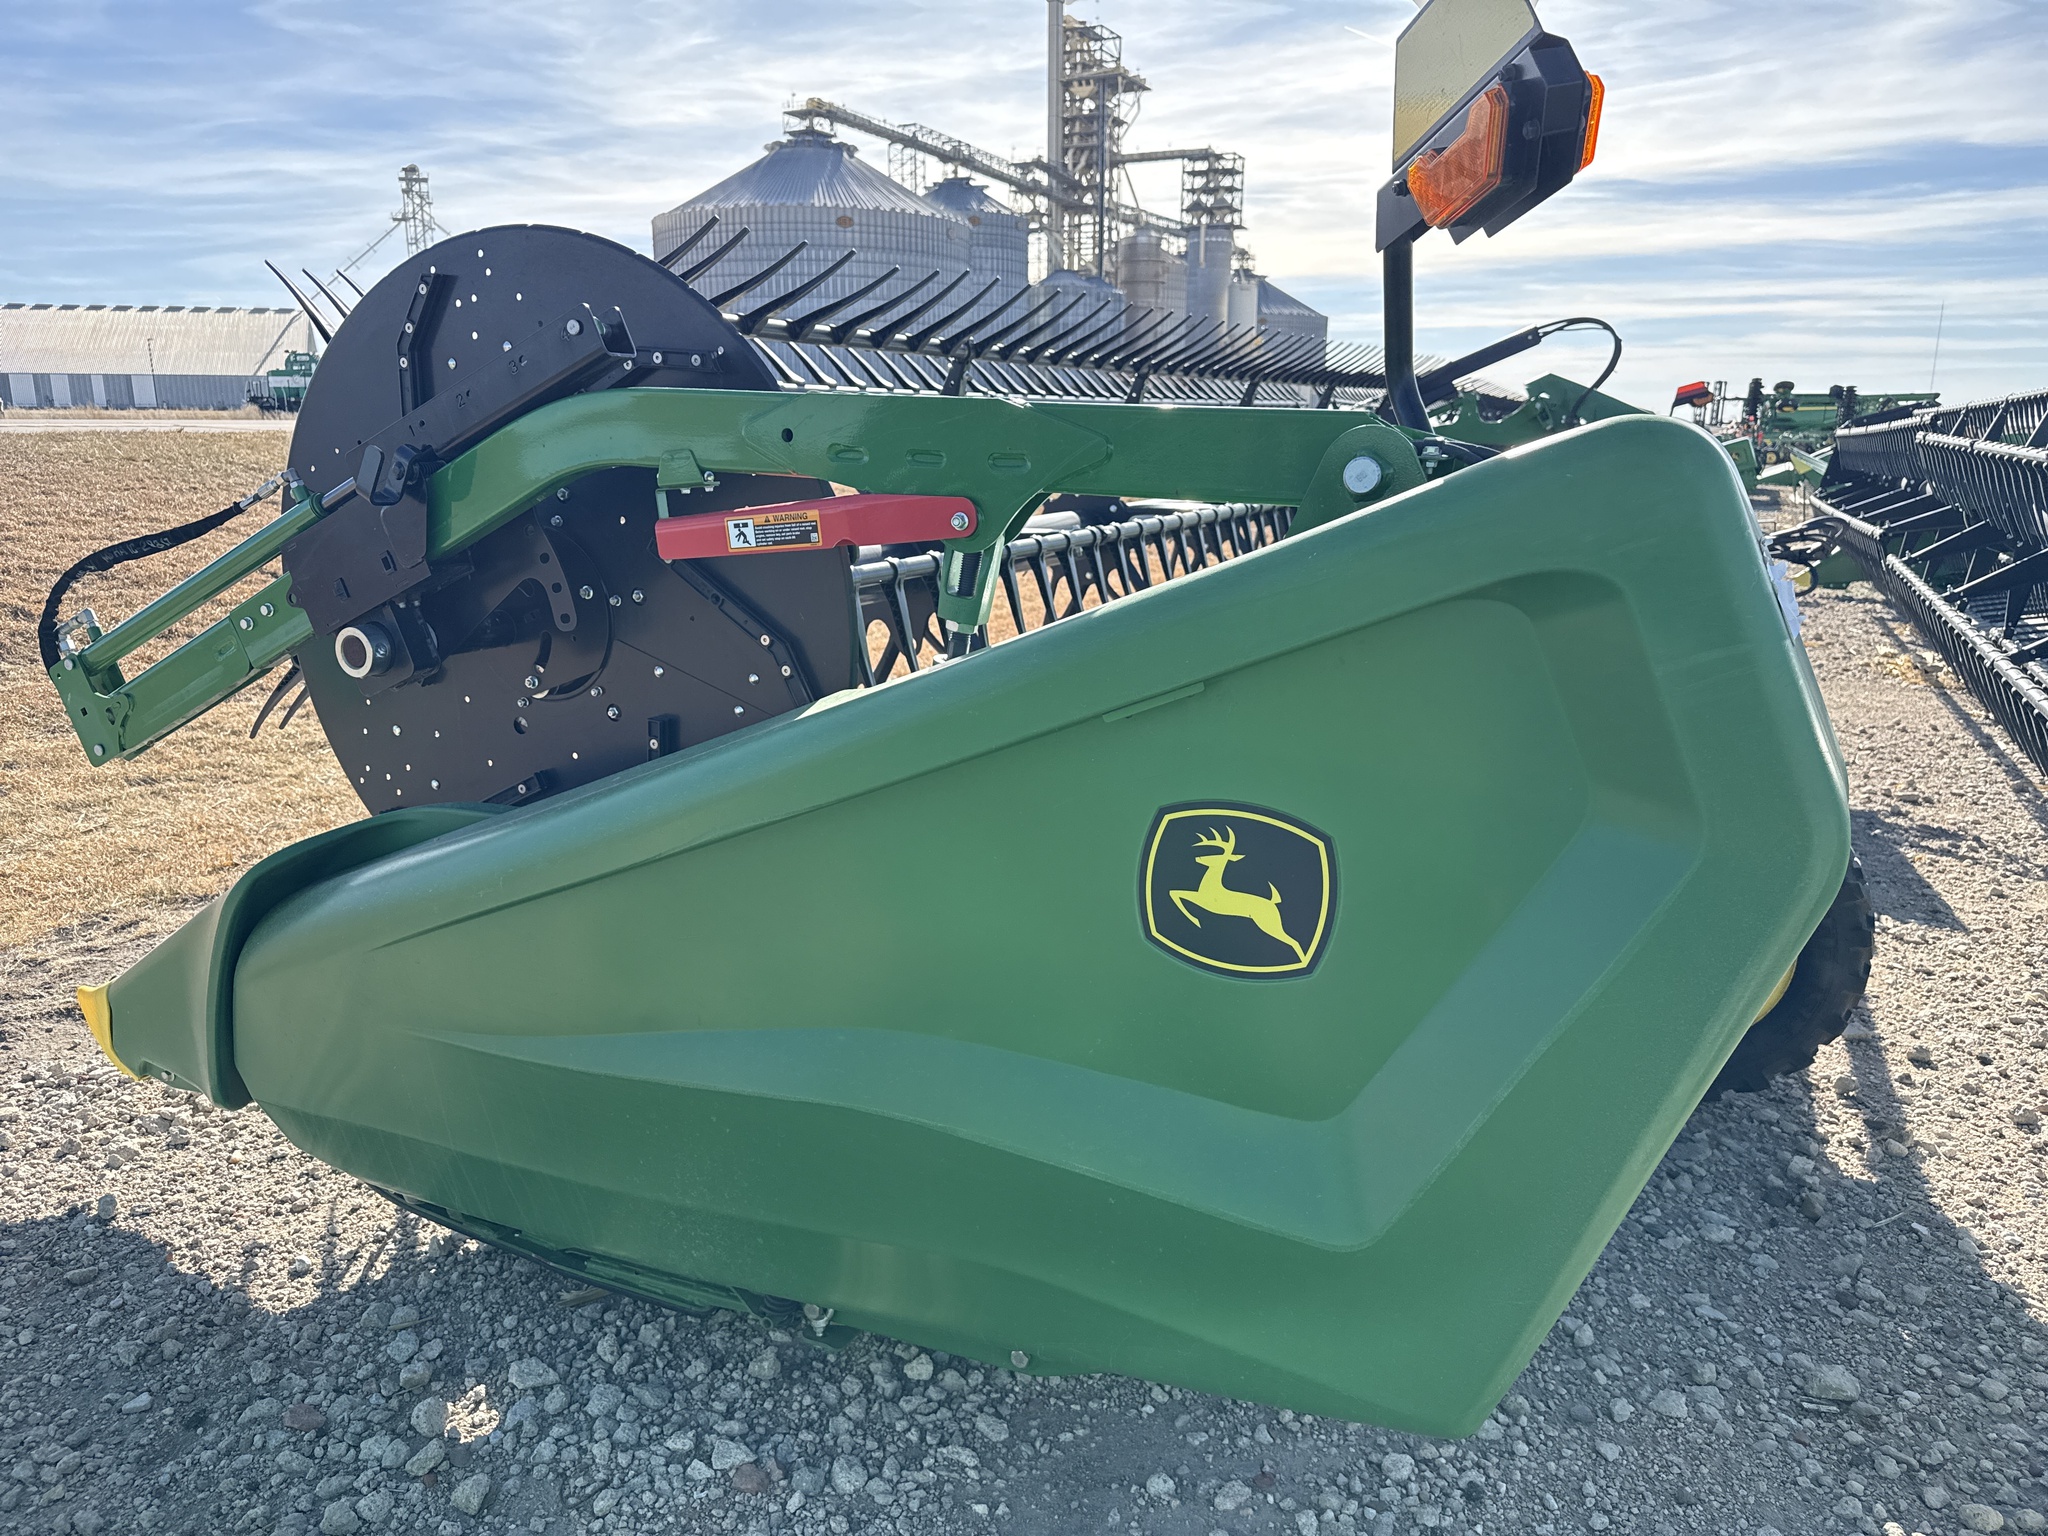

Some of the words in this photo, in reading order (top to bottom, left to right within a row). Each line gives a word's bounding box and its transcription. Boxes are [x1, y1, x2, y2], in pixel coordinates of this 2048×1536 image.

[455, 393, 466, 408] 2
[508, 360, 519, 375] 3
[772, 512, 808, 522] WARNING
